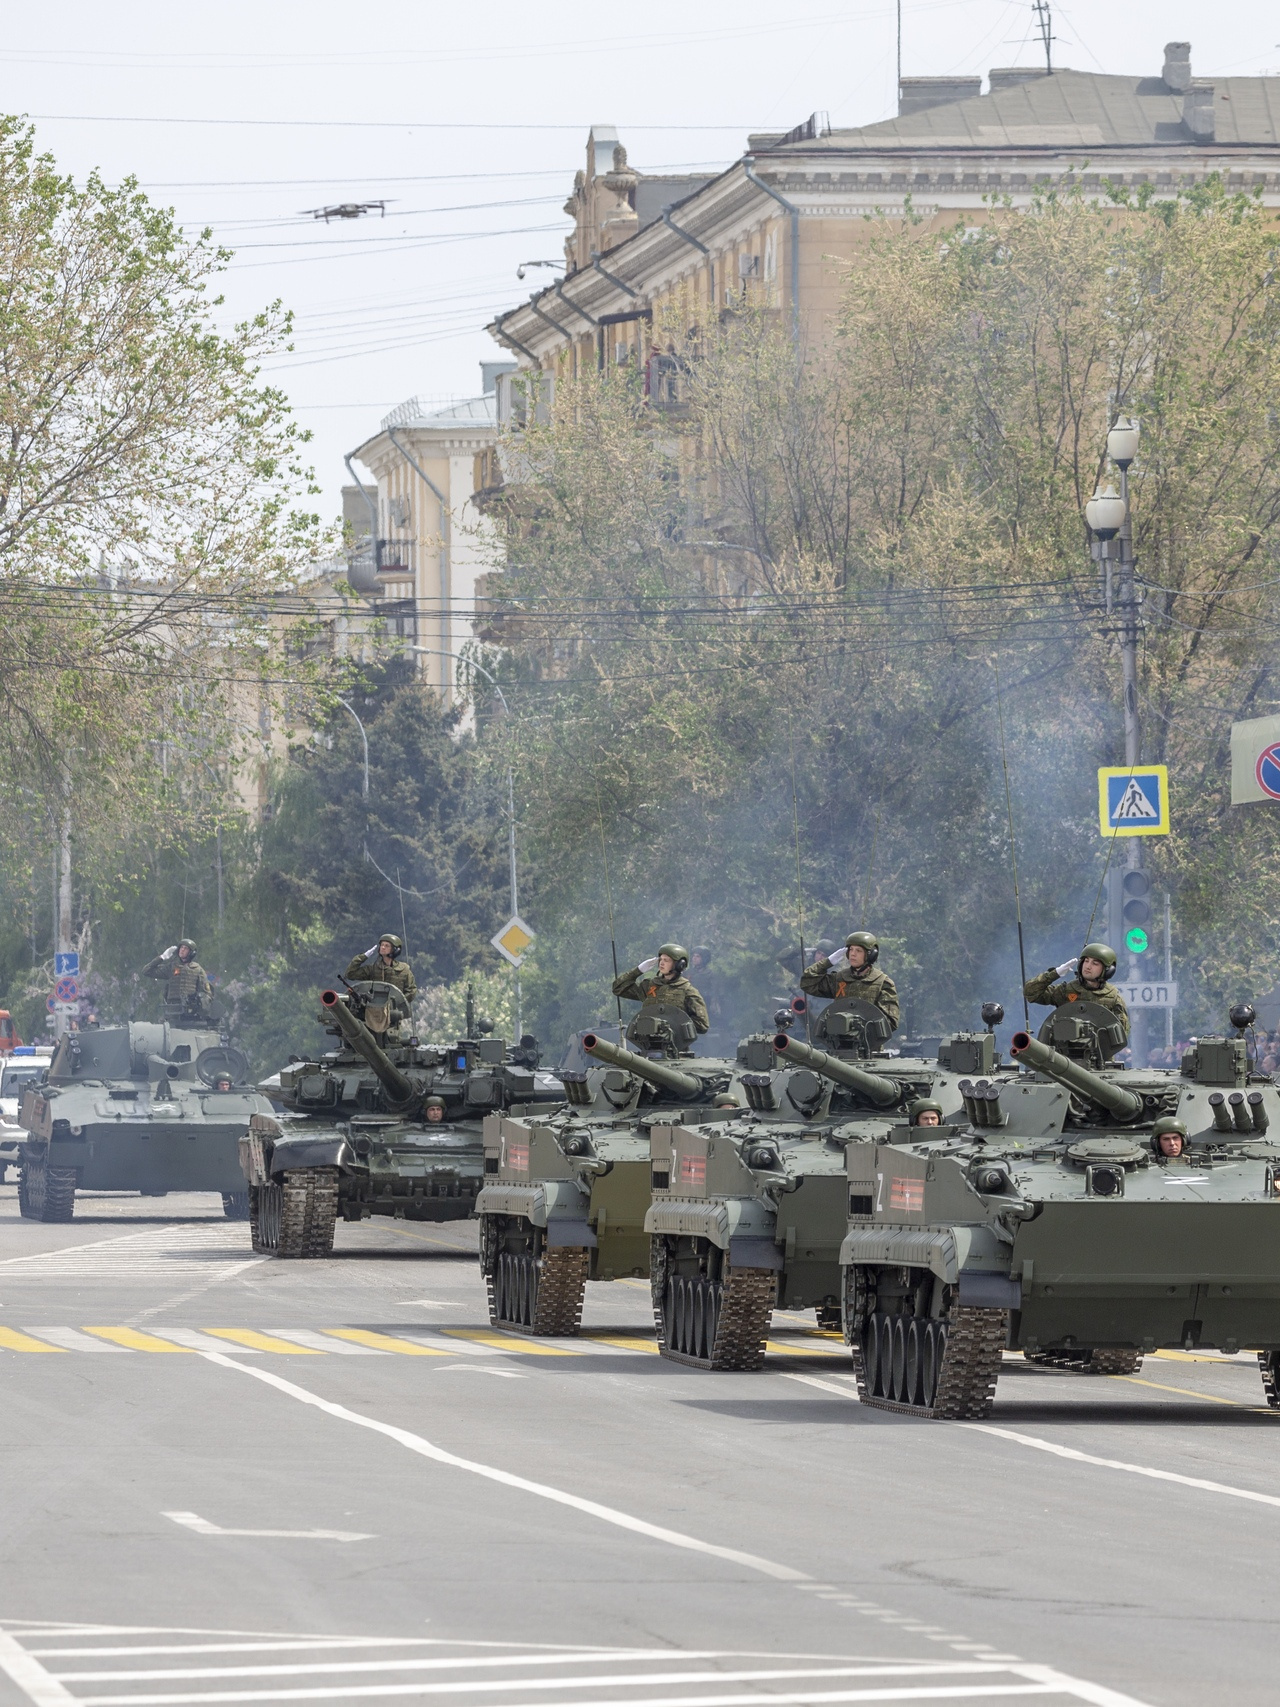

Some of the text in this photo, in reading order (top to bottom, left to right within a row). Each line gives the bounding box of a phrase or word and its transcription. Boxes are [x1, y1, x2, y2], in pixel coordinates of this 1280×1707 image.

[1118, 987, 1168, 1003] ТОП
[672, 1149, 677, 1183] Z
[876, 1173, 884, 1212] Z
[1161, 1176, 1210, 1185] Z
